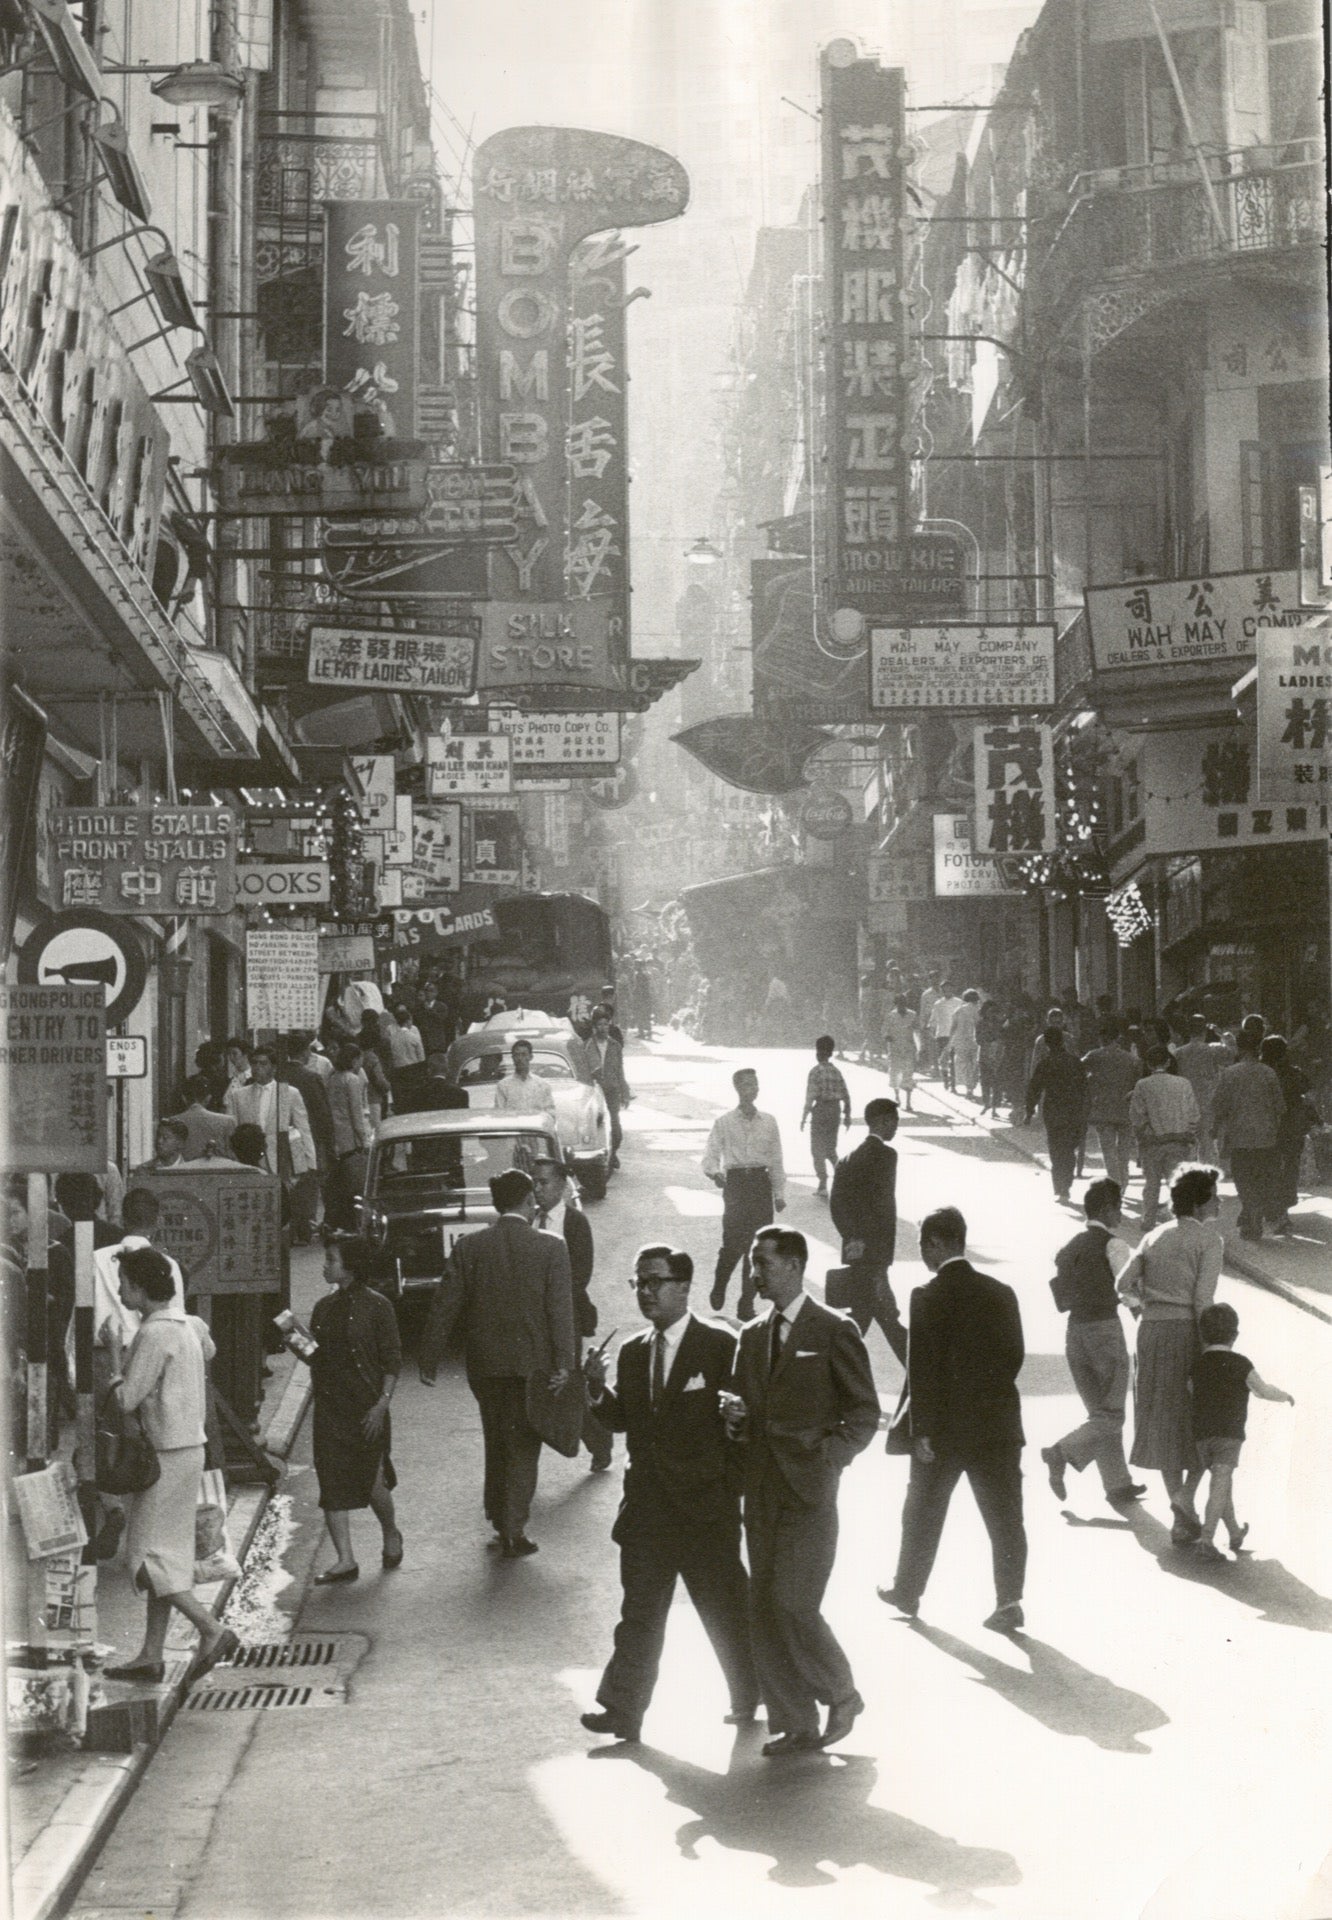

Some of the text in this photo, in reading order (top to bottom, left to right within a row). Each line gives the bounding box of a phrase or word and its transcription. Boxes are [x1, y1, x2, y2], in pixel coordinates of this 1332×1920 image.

[498, 224, 556, 590] BOMBAY
[508, 613, 576, 639] SILK
[1128, 625, 1171, 649] WAH
[1185, 618, 1227, 643] MAY
[490, 645, 594, 671] STORE
[890, 641, 1038, 653] WAH MAY COMPANY
[1108, 640, 1250, 664] DEALERS & EXPORTERS OF
[879, 656, 936, 666] DEALERS
[960, 655, 1026, 665] EXPORTERS
[334, 660, 359, 679] FAT
[420, 666, 467, 686] TAILOR
[528, 721, 561, 733] PHOTO
[565, 721, 590, 733] COPY
[474, 772, 504, 780] TAILOR
[151, 813, 232, 836] STALLS
[57, 839, 227, 861] FRONT STALLS
[434, 907, 494, 936] CARDS
[331, 959, 371, 969] TAILOR
[7, 1016, 100, 1041] ENTRY TO
[40, 1047, 101, 1064] DRIVERS
[109, 1041, 137, 1050] ENDS
